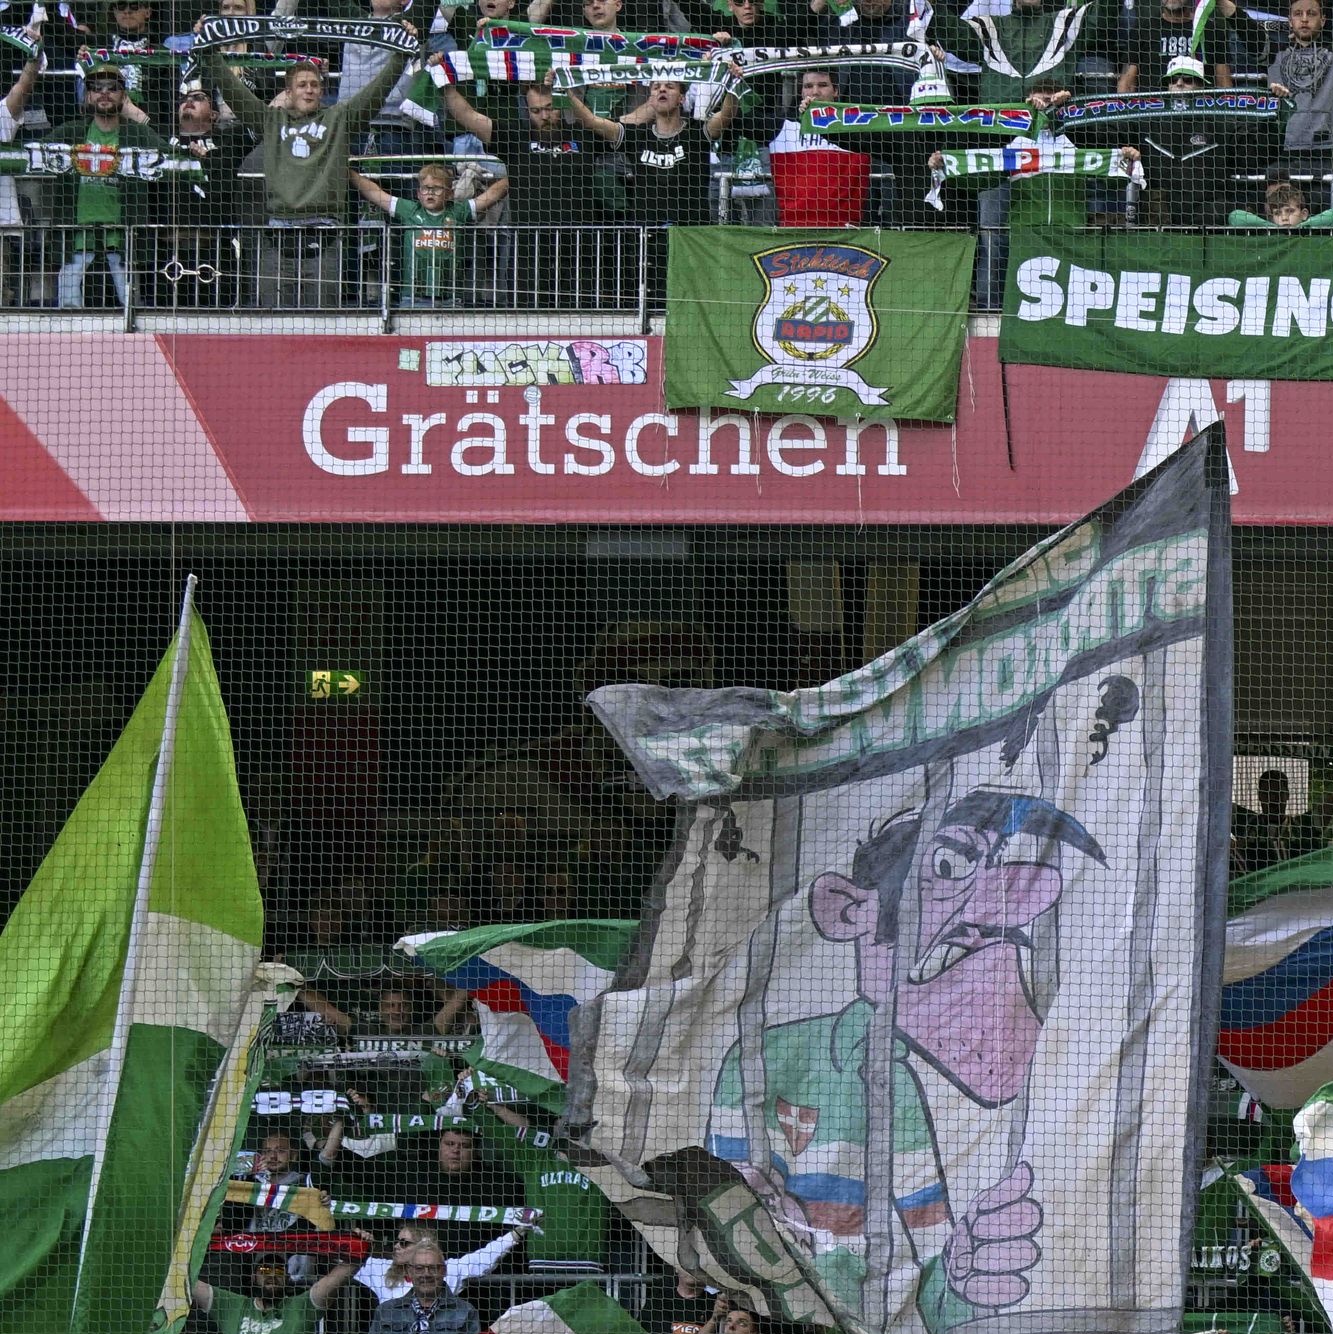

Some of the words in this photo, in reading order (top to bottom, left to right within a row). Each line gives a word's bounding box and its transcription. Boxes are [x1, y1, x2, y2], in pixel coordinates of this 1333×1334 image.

[810, 106, 1033, 130] ULTRAS
[946, 150, 1103, 176] RAPID
[422, 229, 450, 239] WIEN
[781, 323, 849, 340] RAPID
[441, 344, 573, 386] FUCK
[570, 344, 647, 385] RB
[777, 384, 837, 403] 1996
[541, 1171, 589, 1190] ULTRAS
